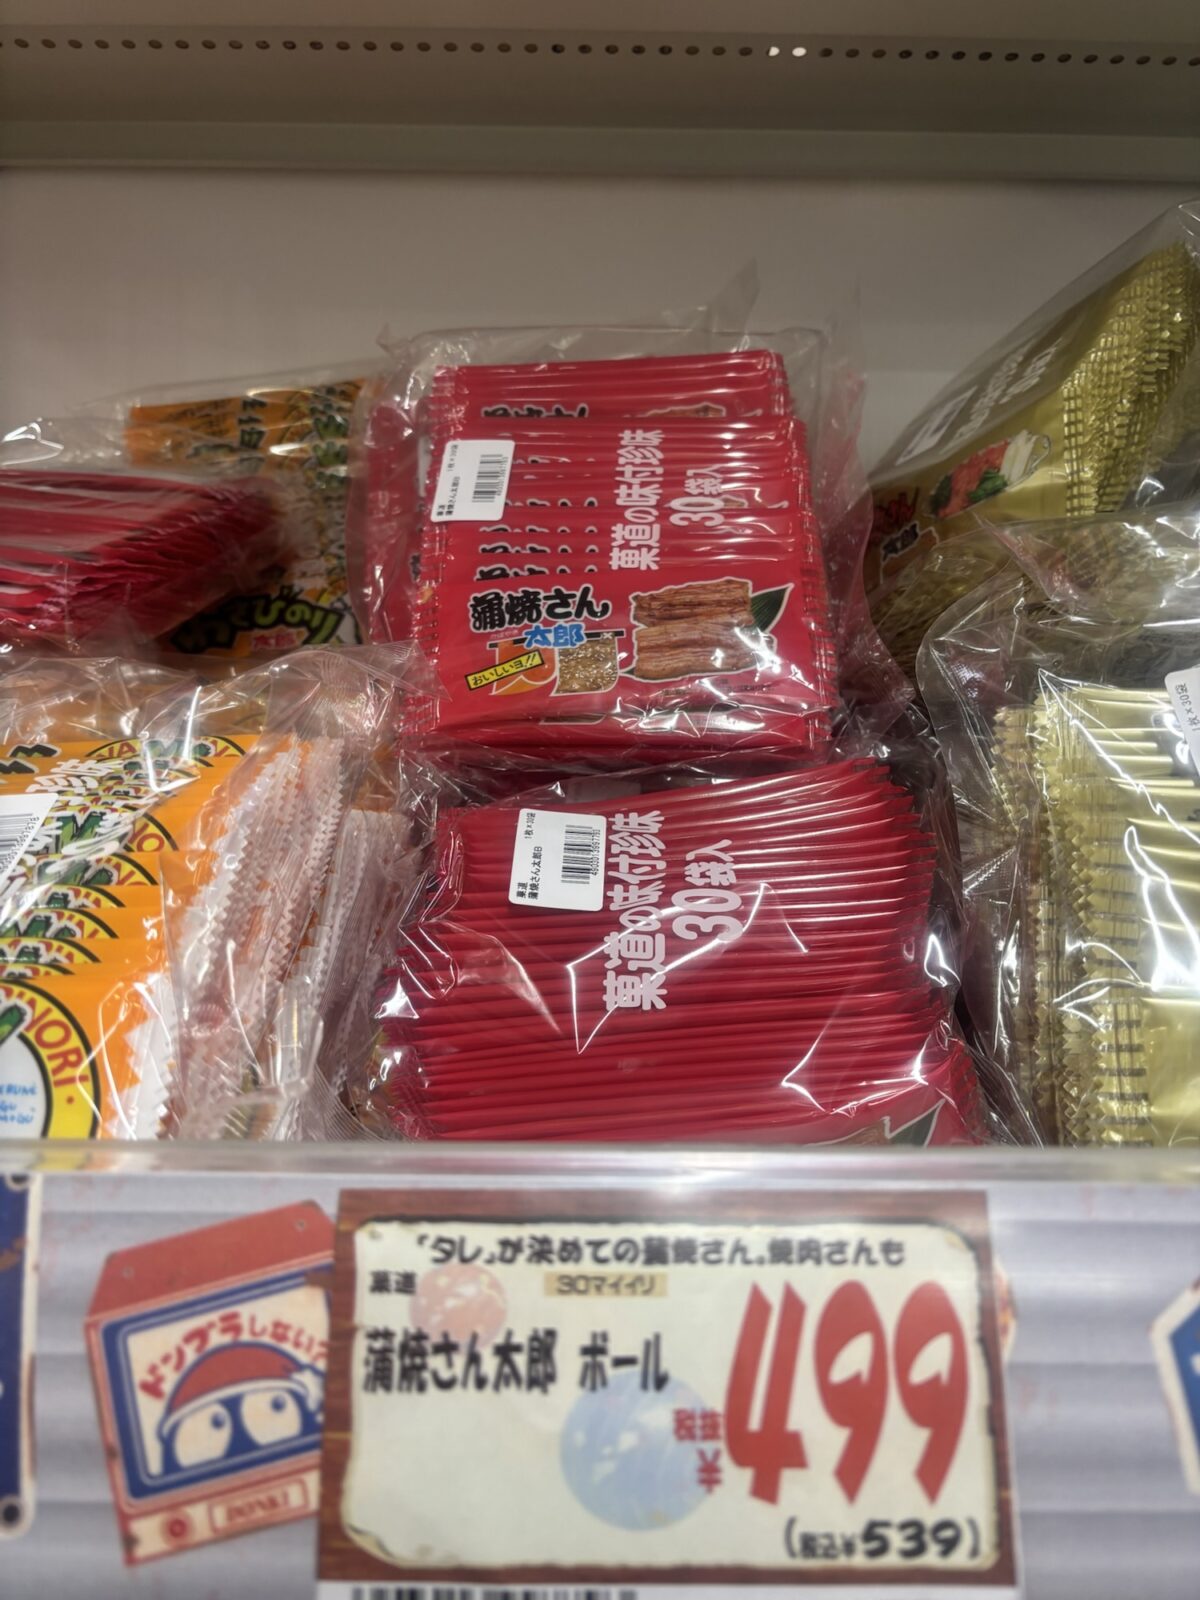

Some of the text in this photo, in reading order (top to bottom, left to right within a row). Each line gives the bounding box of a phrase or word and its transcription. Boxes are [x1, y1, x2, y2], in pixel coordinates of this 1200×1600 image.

[608, 429, 666, 571] 菓道の味付珍味
[668, 463, 725, 528] 30袋入
[470, 585, 612, 632] 蒲焼さん
[523, 623, 586, 648] 太郎
[602, 809, 668, 1012] 菓道の味付珍味
[670, 838, 744, 943] 30袋入
[368, 1269, 417, 1295] 菓道
[556, 1273, 656, 1296] 30マイイリ
[362, 1328, 670, 1394] 蒲焼さん太郎 ボール
[724, 1279, 970, 1506] 499
[696, 1447, 722, 1494] ¥
